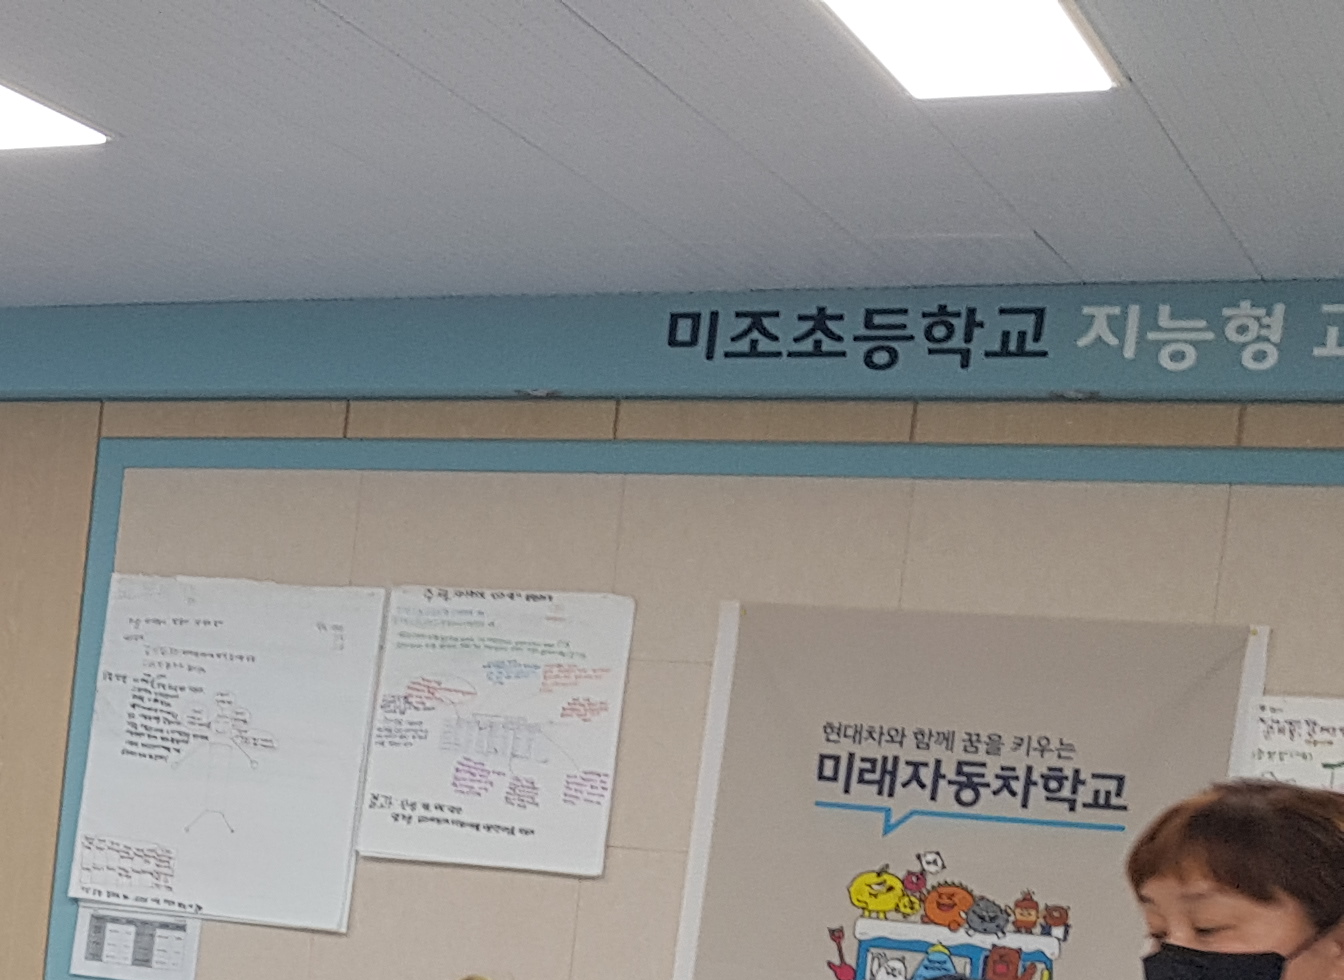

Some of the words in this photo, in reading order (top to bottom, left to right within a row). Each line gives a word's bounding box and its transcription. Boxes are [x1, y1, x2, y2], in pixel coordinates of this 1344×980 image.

[667, 305, 1049, 370] 미조초등학교
[1076, 300, 1286, 371] 지능형
[822, 721, 906, 748] 현대차와
[912, 727, 955, 752] 함께
[962, 731, 1005, 756] 꿈을
[1012, 735, 1077, 760] 키우는
[817, 752, 1128, 812] 미래자동차학교
